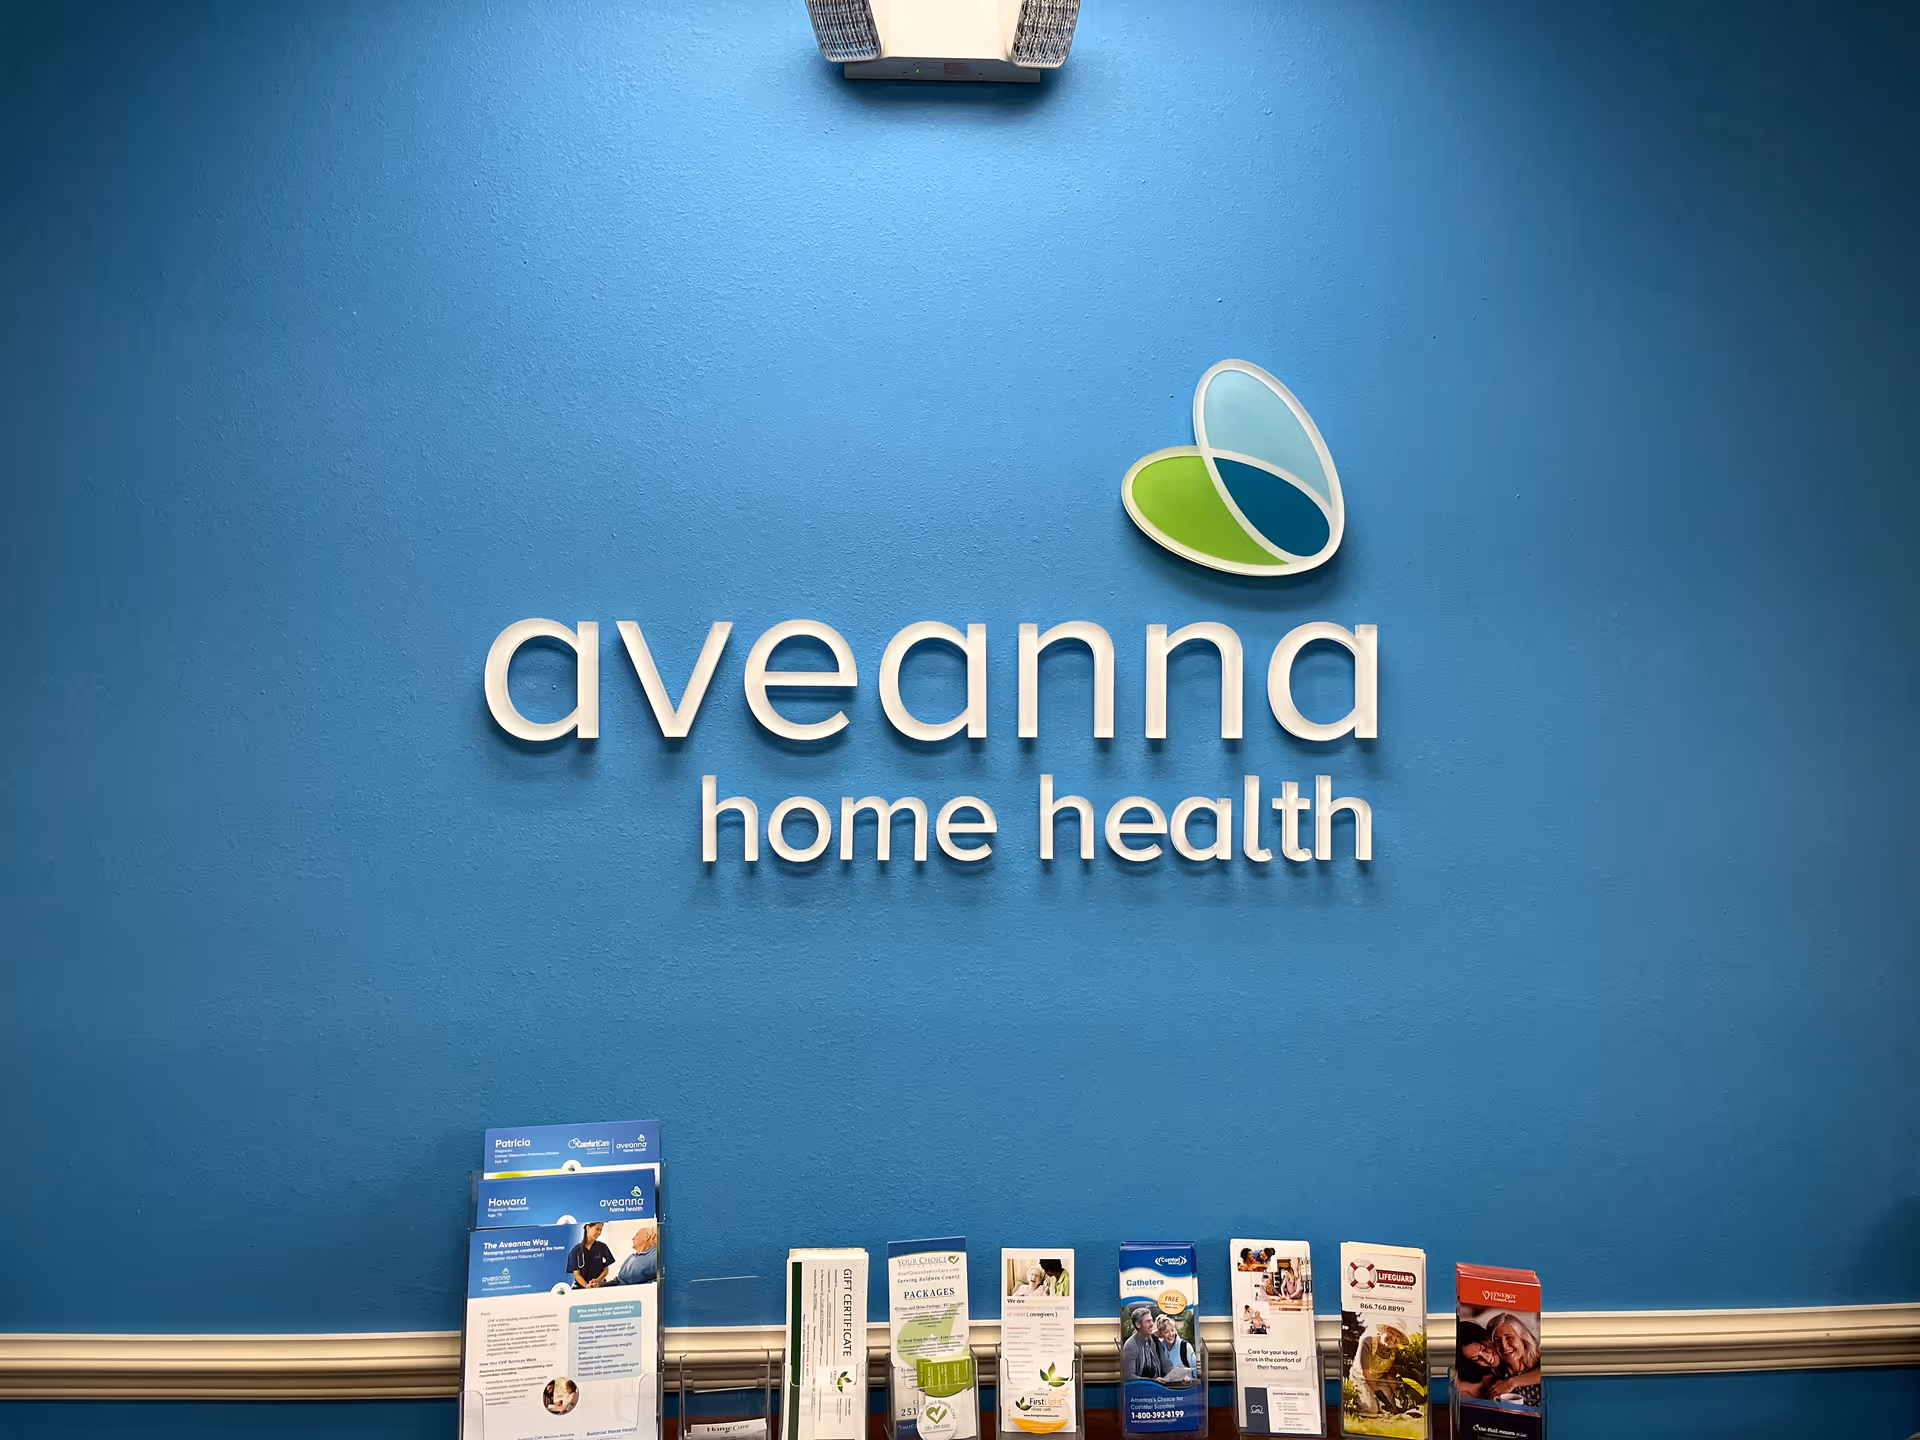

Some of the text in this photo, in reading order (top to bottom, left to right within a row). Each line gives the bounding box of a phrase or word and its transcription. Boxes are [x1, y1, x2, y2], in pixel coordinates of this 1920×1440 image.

[484, 617, 1379, 741] aveanna
[702, 774, 1372, 864] home health
[495, 1138, 530, 1148] Patricia
[488, 1197, 527, 1207] Howard
[600, 1198, 644, 1207] aveanna
[499, 1240, 530, 1248] Aveanna
[532, 1239, 548, 1247] Way
[1378, 1273, 1414, 1282] LIFEGUARD
[904, 1287, 955, 1299] PACKAGES
[1491, 1291, 1516, 1299] SYNERGY
[843, 1268, 852, 1356] GIFT CERTIFICATE
[1360, 1302, 1404, 1312] 866.760.8899
[1131, 1410, 1184, 1419] 1-800-393-8199
